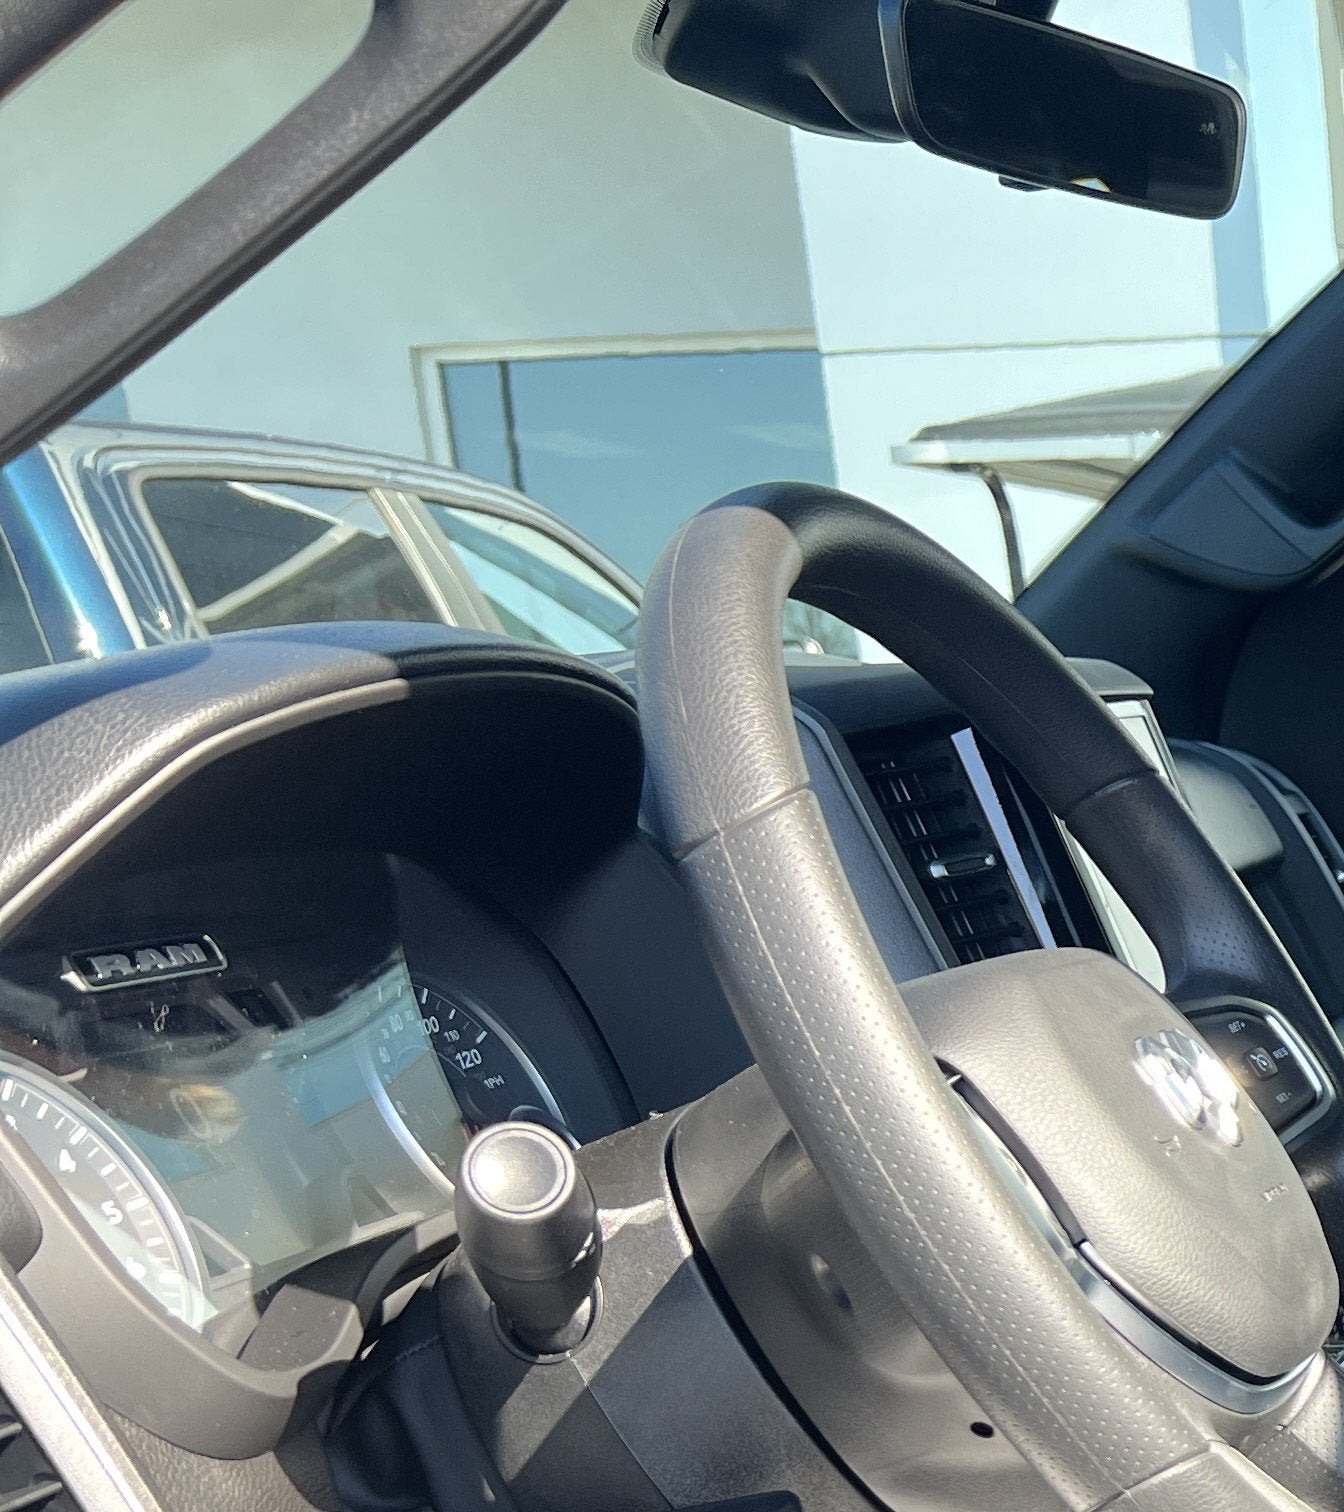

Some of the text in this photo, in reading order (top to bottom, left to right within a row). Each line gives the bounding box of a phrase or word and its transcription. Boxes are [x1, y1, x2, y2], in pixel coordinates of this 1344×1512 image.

[87, 943, 207, 980] RAM
[455, 1048, 482, 1070] 120
[59, 1149, 77, 1173] 4
[101, 1200, 124, 1225] 5
